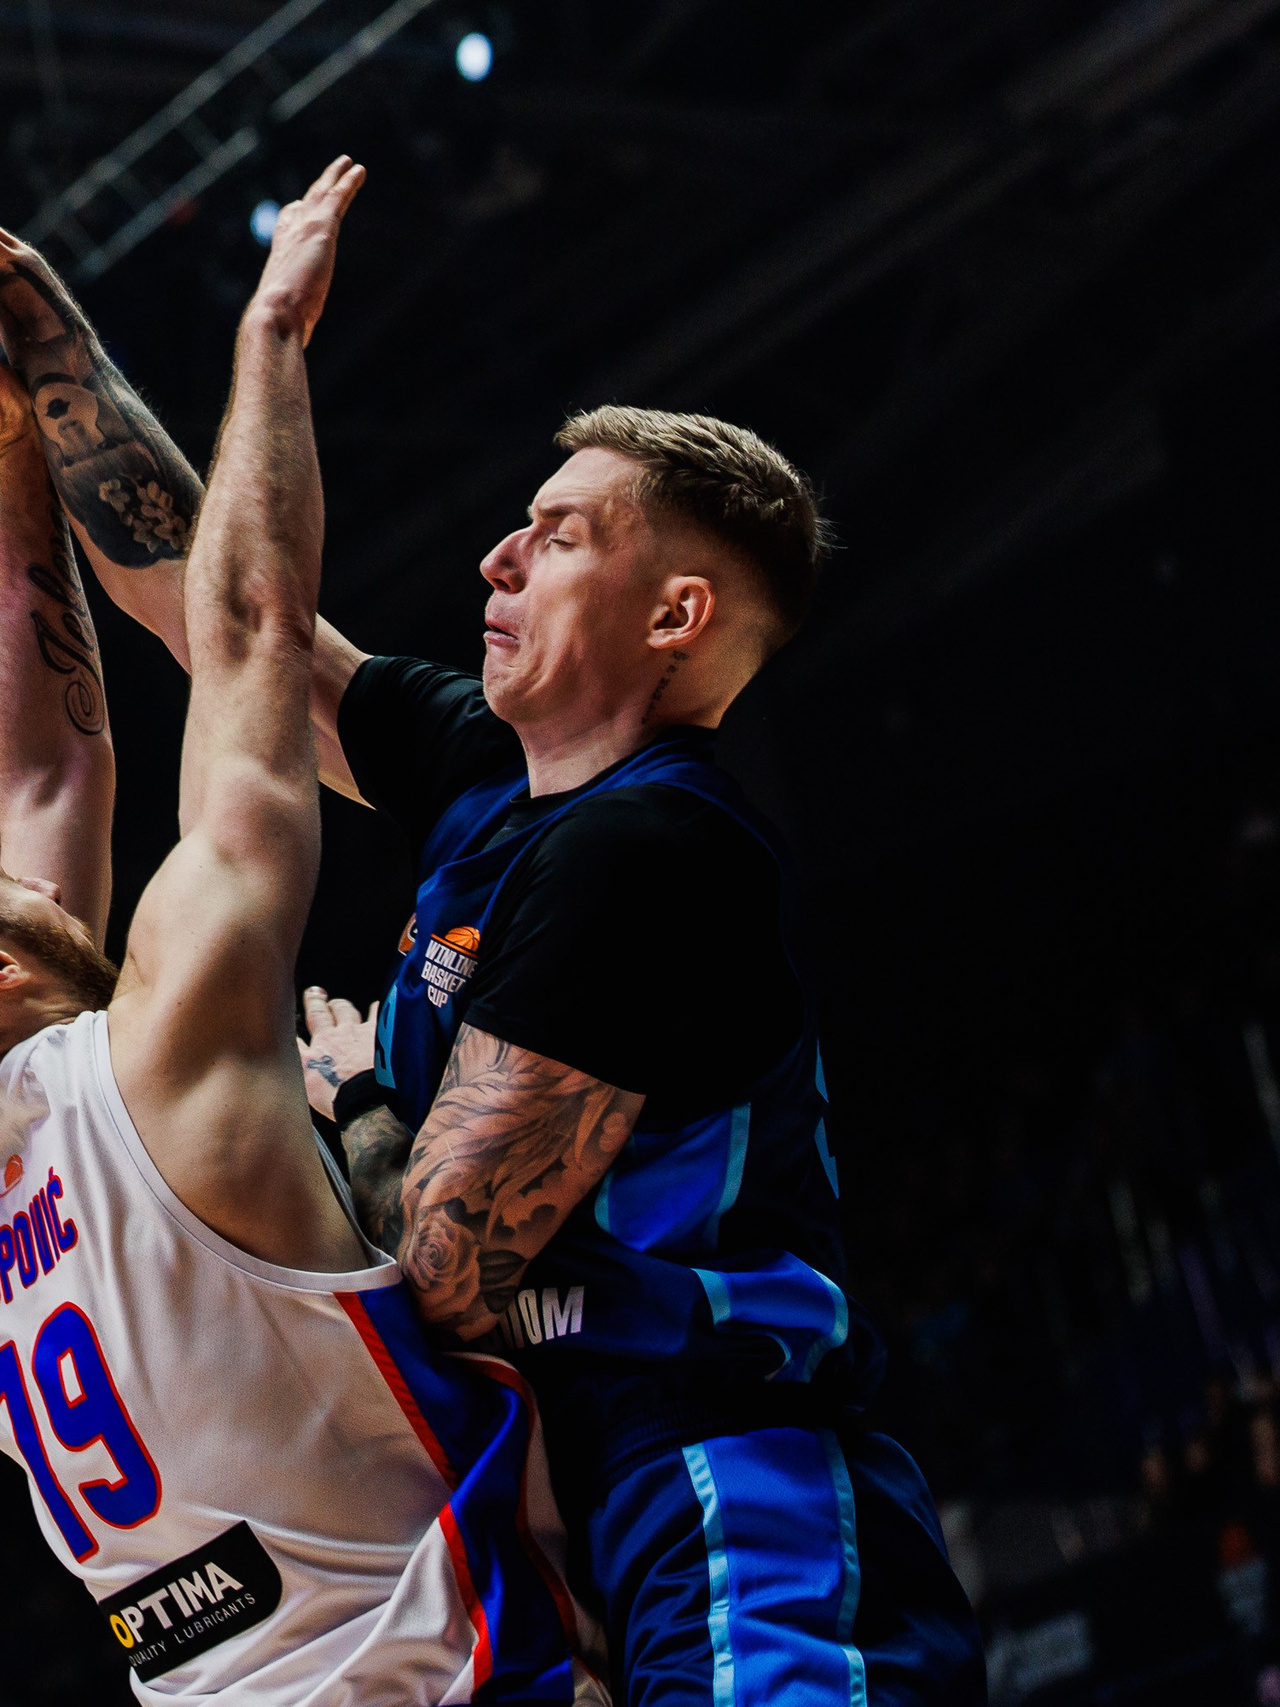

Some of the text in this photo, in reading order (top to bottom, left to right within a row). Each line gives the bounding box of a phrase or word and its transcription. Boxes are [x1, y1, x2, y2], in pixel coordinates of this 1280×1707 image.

[420, 960, 467, 993] BASKET
[424, 939, 479, 979] WINLINE
[427, 984, 449, 1009] CUP
[109, 1561, 244, 1648] OPTIMA
[128, 1593, 257, 1667] QUALITY LUBRICANTS
